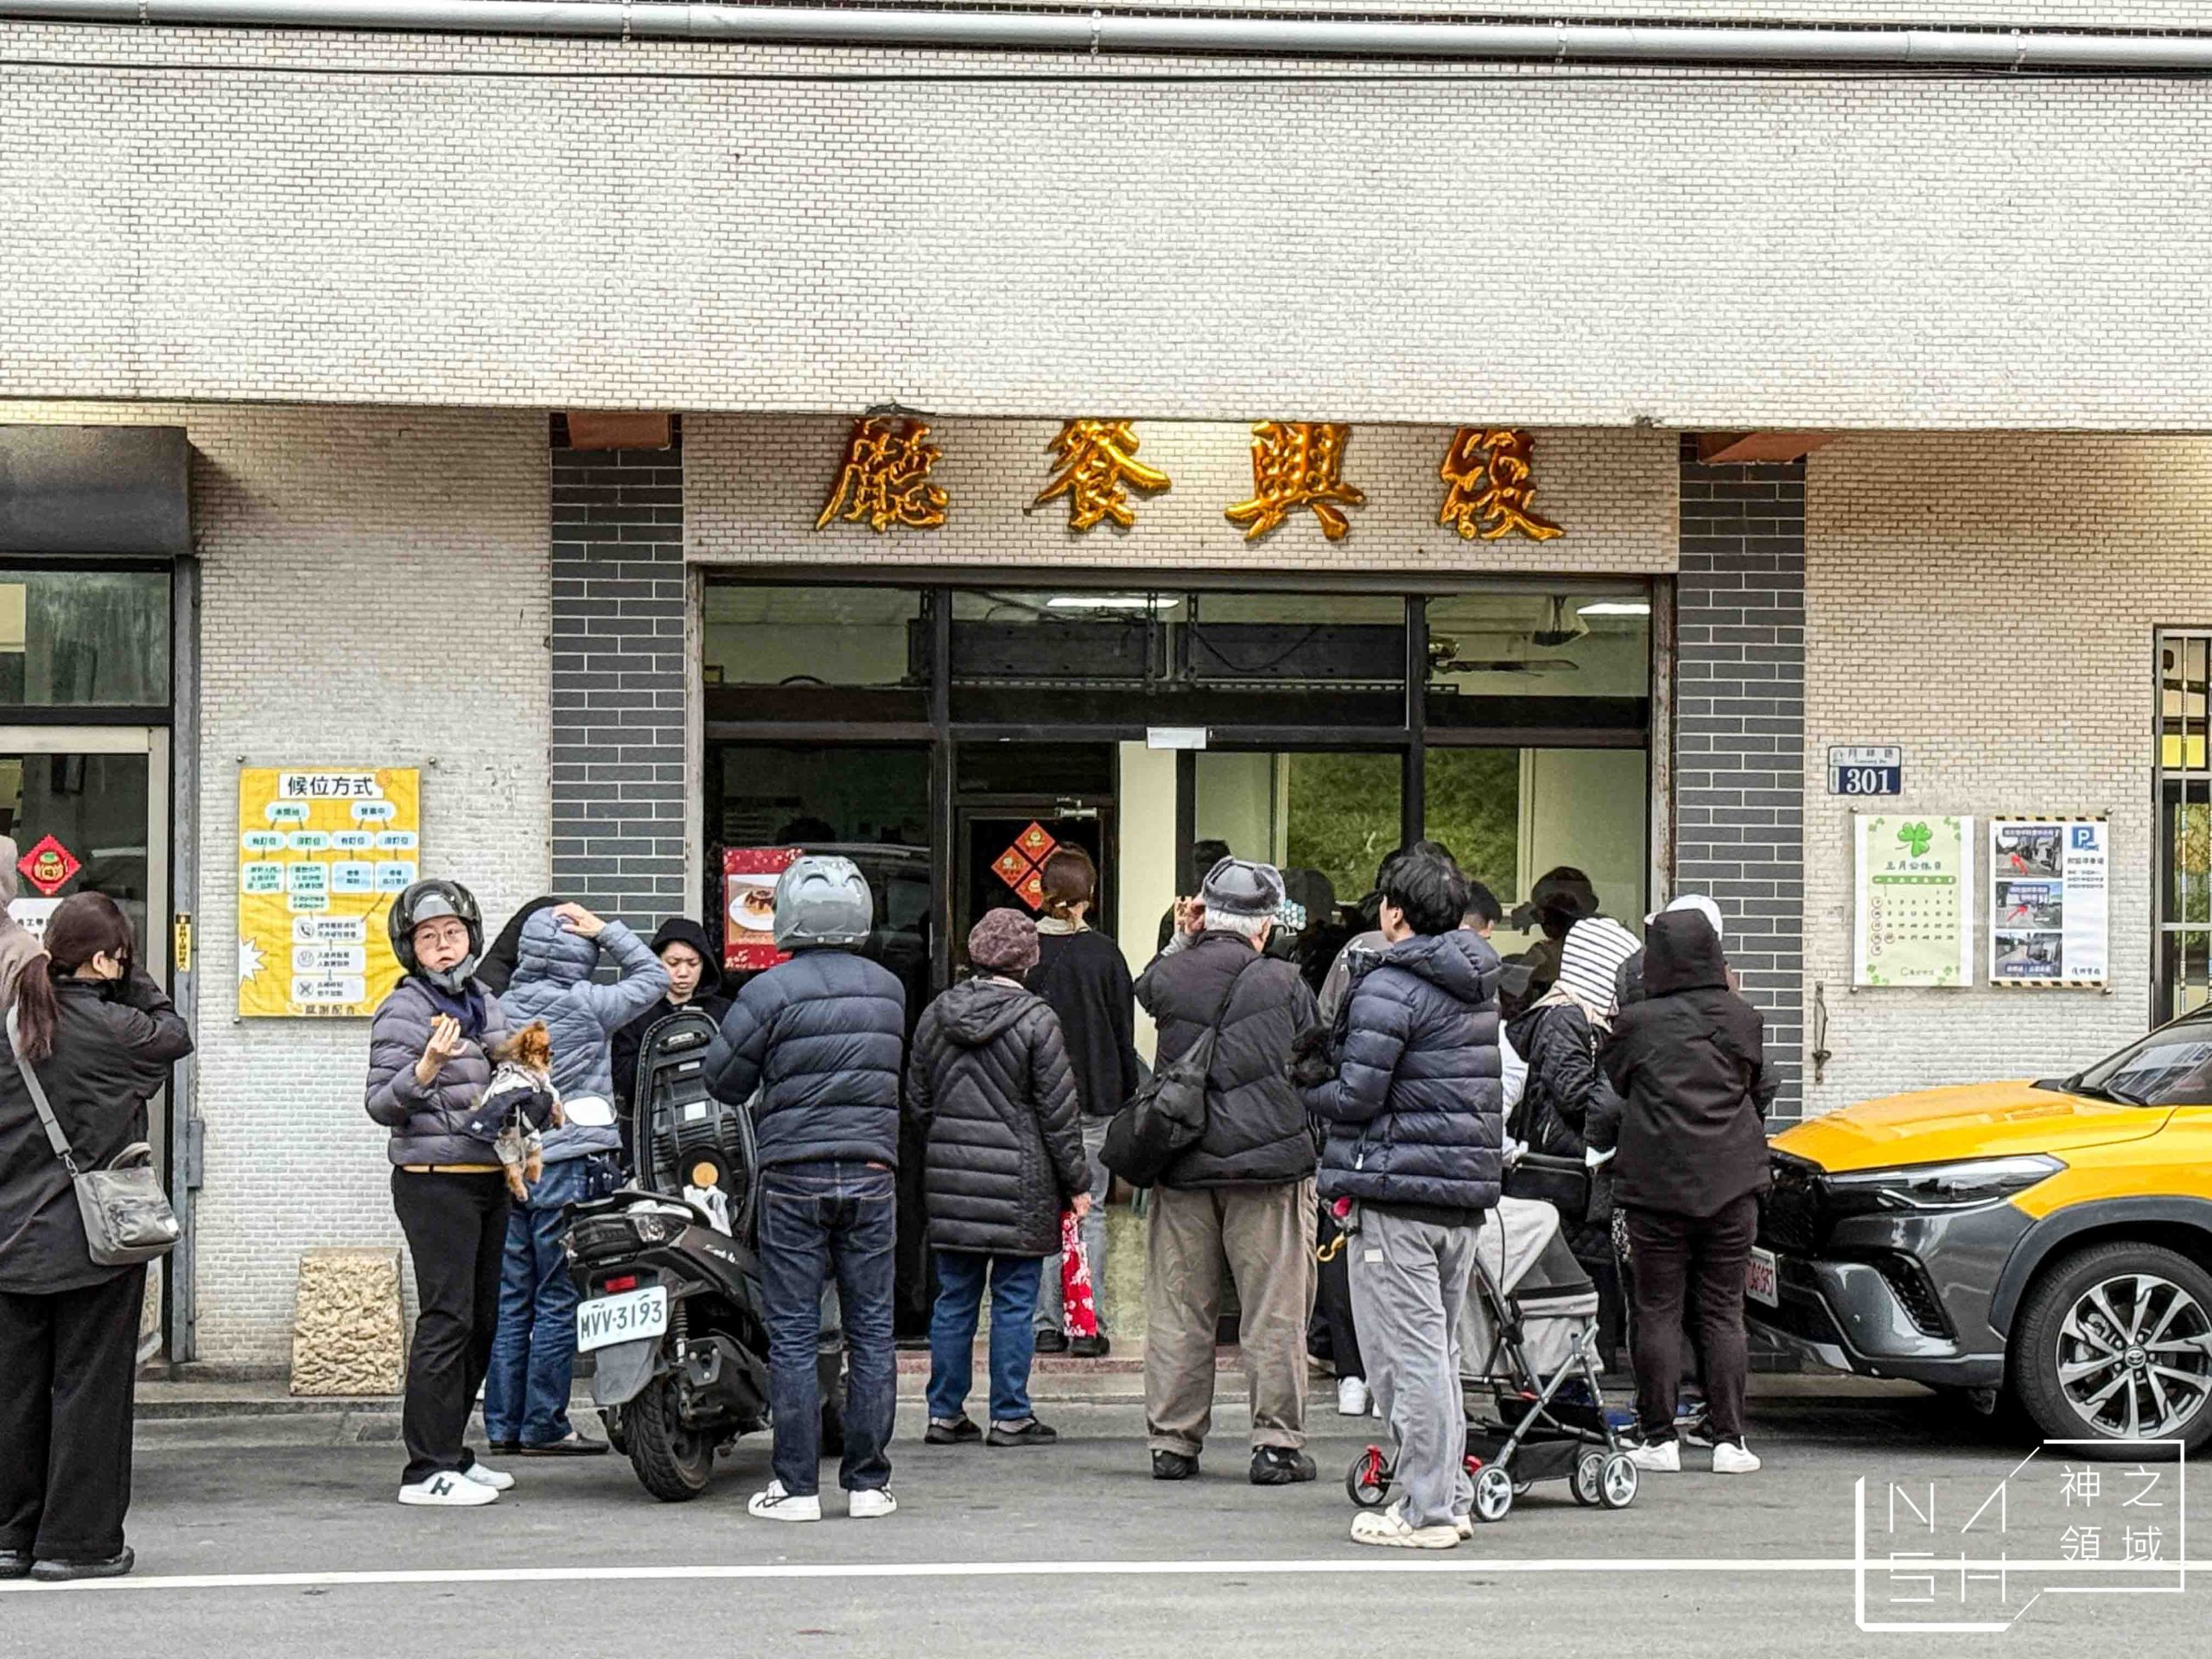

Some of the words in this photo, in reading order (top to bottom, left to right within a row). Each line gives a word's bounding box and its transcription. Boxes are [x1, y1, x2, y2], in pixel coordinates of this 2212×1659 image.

[288, 776, 373, 796] 候位方式
[1846, 768, 1892, 794] 301
[2077, 830, 2090, 848] P
